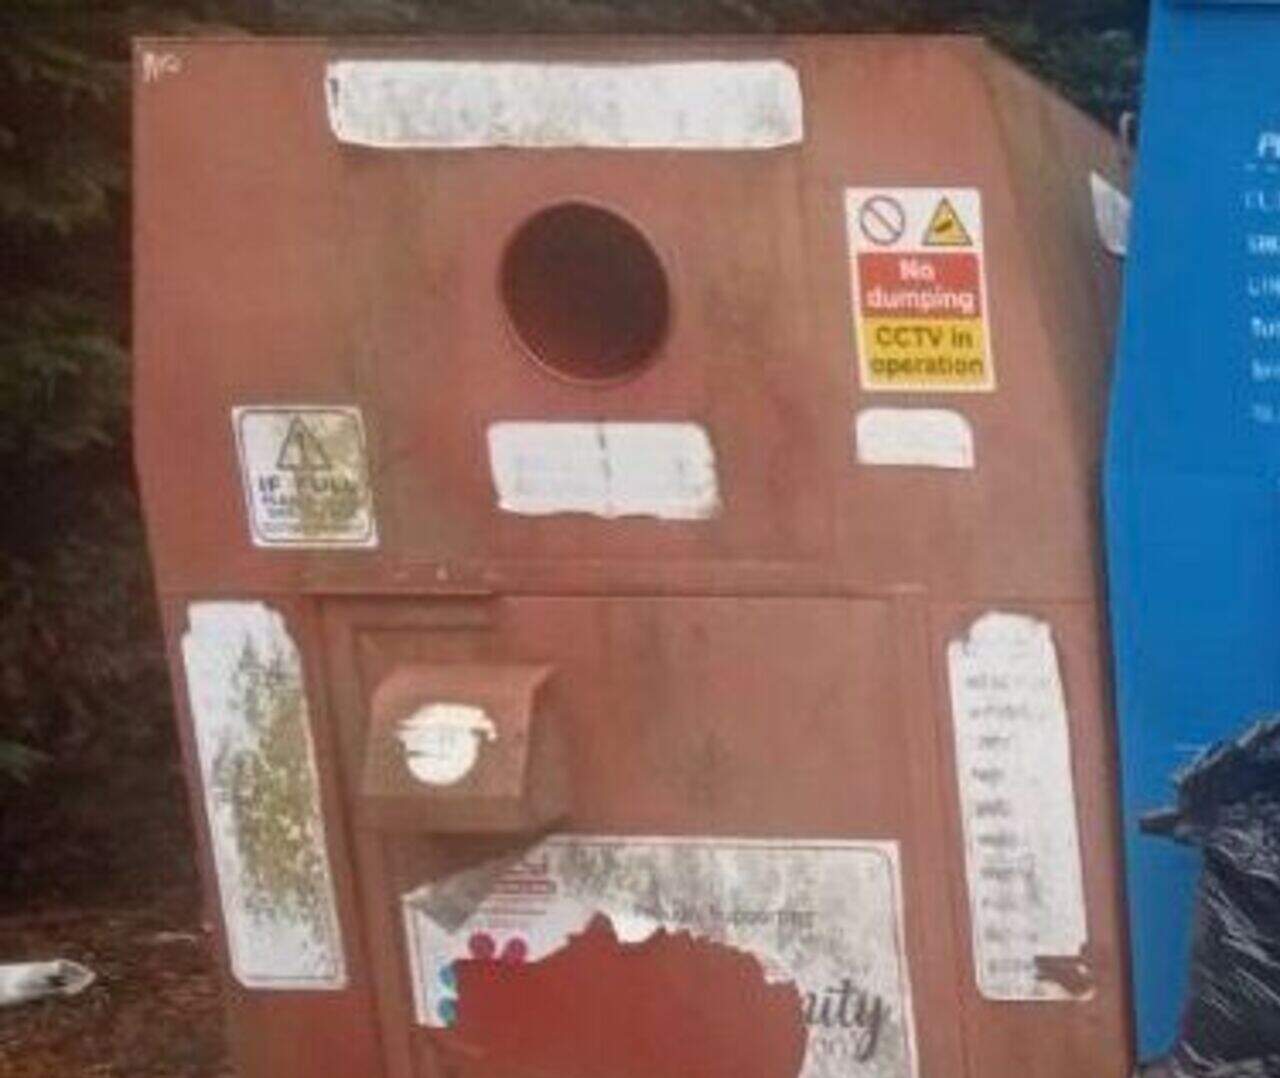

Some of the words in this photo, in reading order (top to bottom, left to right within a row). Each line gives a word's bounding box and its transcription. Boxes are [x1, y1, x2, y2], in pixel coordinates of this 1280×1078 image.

[899, 257, 935, 280] No
[866, 285, 974, 314] dumping
[876, 326, 942, 348] CCTV
[952, 325, 972, 348] in
[871, 355, 984, 379] operation
